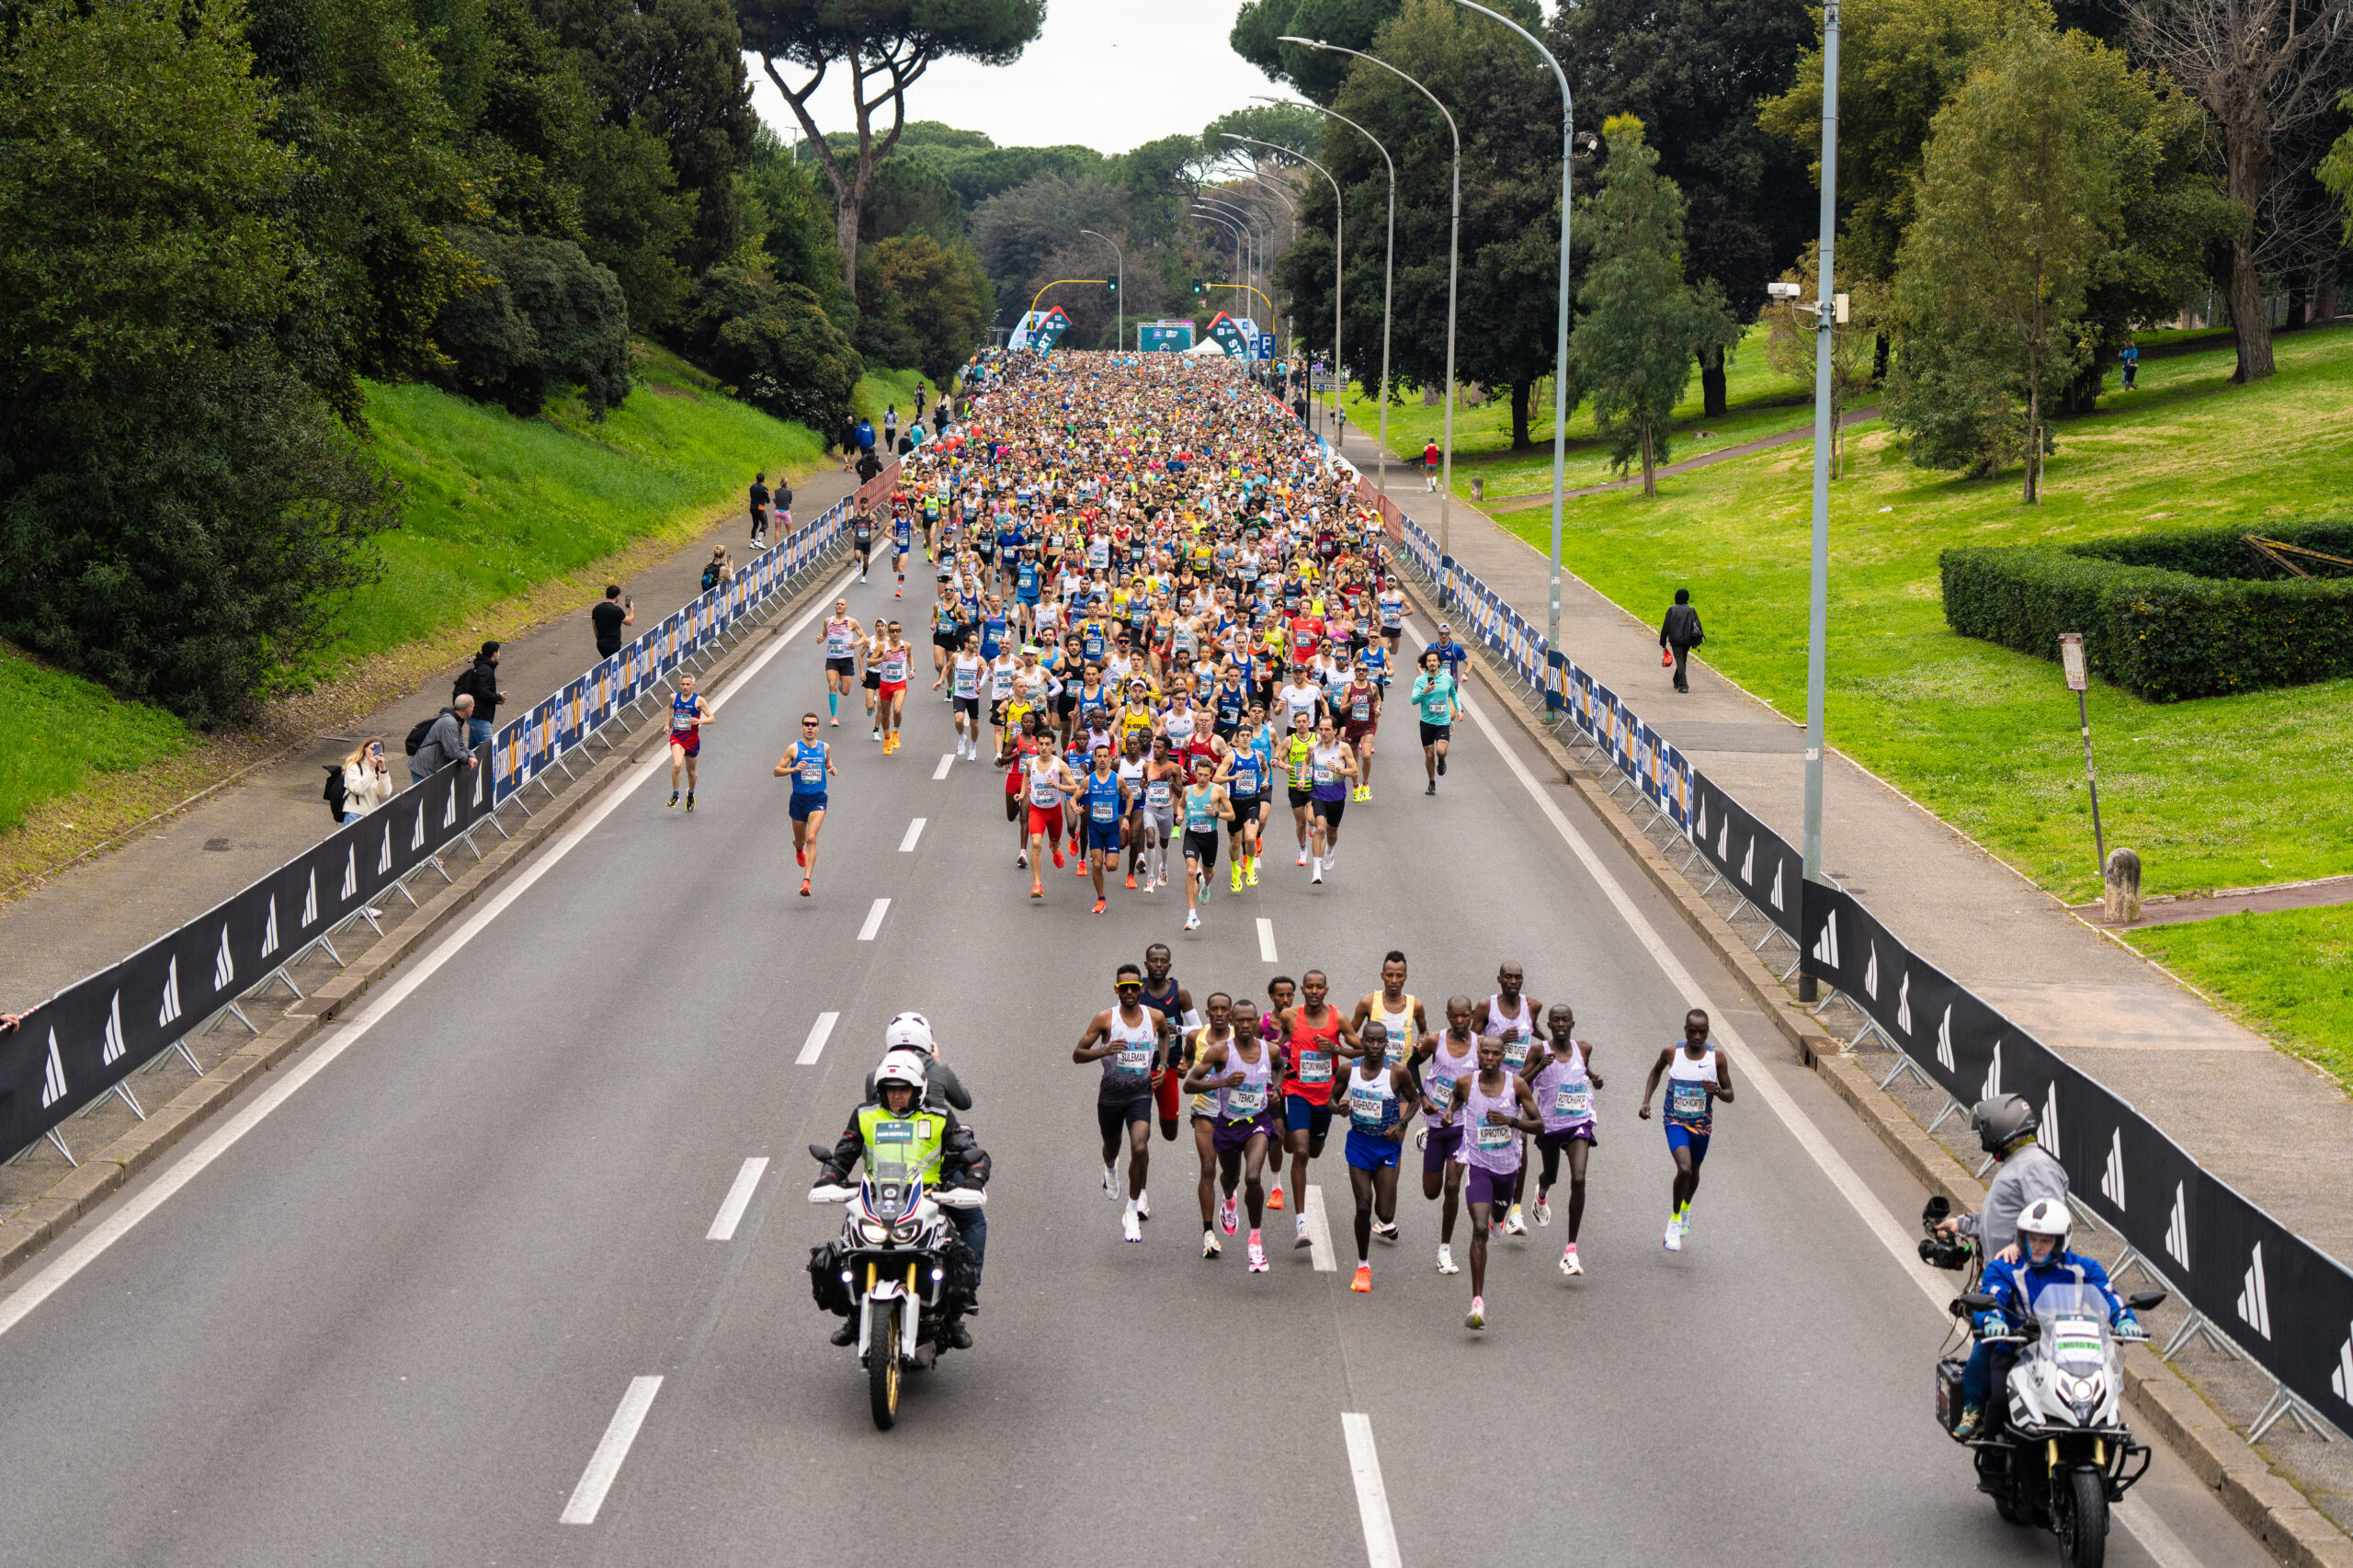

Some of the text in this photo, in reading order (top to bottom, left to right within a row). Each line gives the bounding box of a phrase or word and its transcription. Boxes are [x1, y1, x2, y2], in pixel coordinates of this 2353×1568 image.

[1262, 336, 1271, 349] P
[1120, 1051, 1146, 1062] SULEMAN
[1238, 1093, 1256, 1103] TEMOI
[1352, 1097, 1381, 1112] BUSHENDICH
[1480, 1126, 1508, 1138] KIPROTICH
